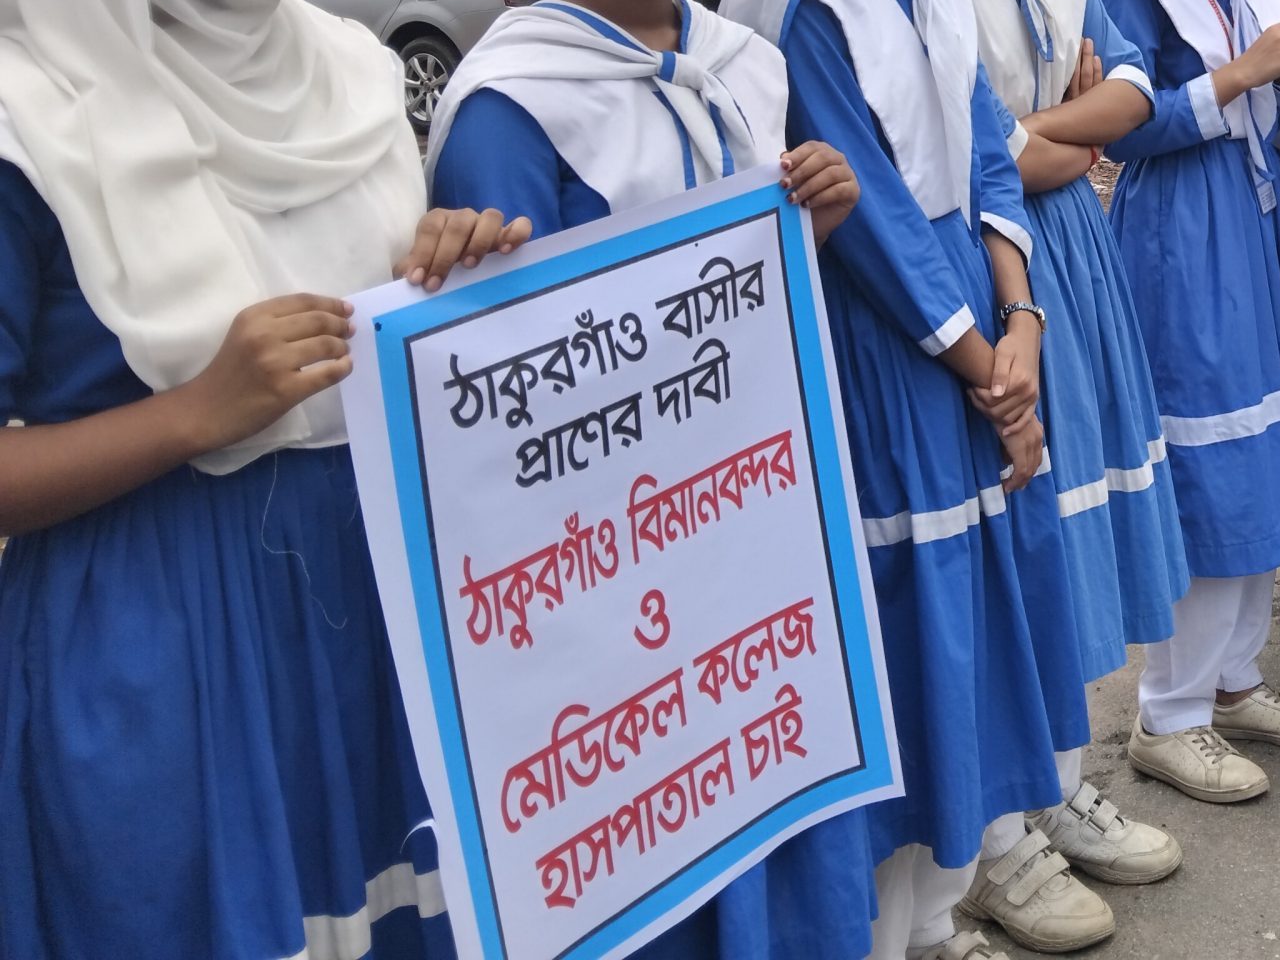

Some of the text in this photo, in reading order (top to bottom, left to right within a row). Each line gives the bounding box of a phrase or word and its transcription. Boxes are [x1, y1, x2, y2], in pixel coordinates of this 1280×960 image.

[443, 256, 765, 428] ঠাকুরগাঁও বাসীর
[514, 338, 731, 488] প্রাণের দাবী
[460, 430, 797, 650] ঠাকুরগাঁও বিমানবন্দর
[634, 589, 670, 650] ও
[501, 597, 817, 833] মেডিকেল কলেজ
[536, 683, 807, 909] হাসপাতাল চাই
